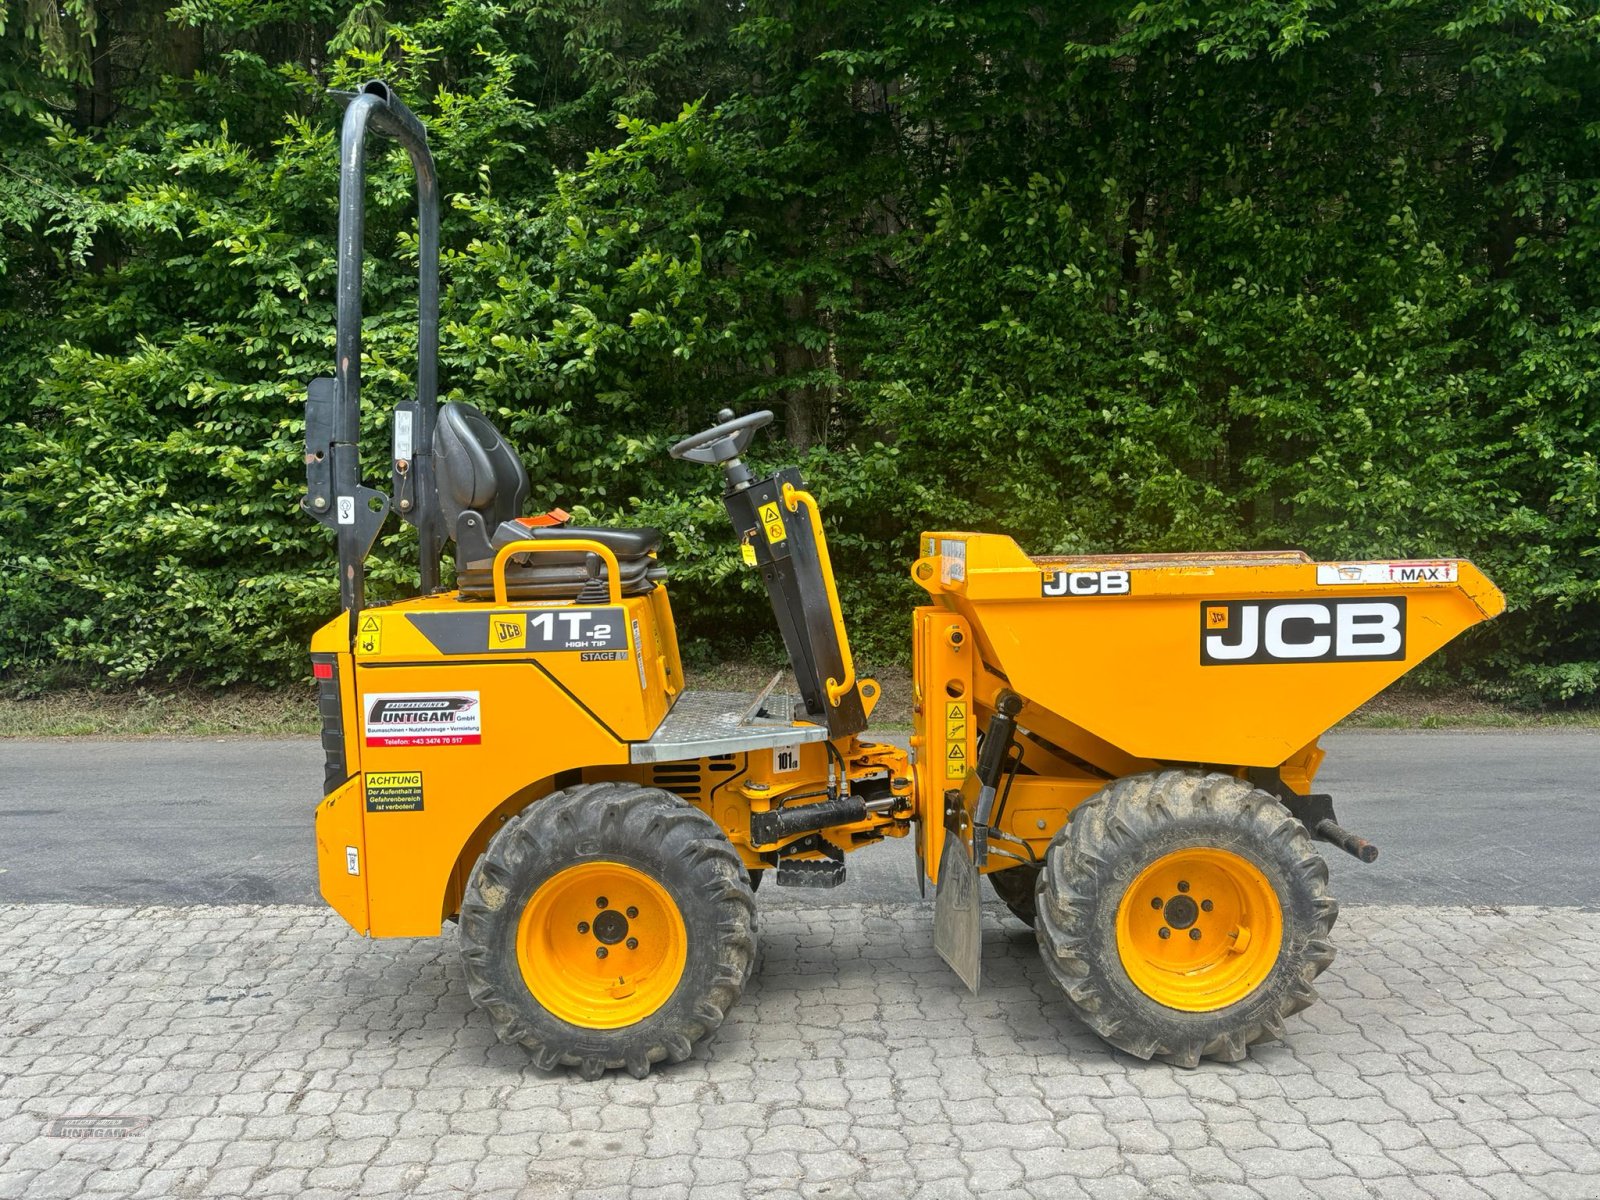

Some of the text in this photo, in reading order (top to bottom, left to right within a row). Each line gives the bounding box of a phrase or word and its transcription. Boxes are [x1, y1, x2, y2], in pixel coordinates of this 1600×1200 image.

[1401, 568, 1439, 581] MAX
[1043, 571, 1130, 595] JCB
[499, 623, 521, 640] JCB
[1206, 603, 1402, 660] JCB
[582, 652, 615, 661] STAGE
[369, 776, 419, 785] ACHTUNG
